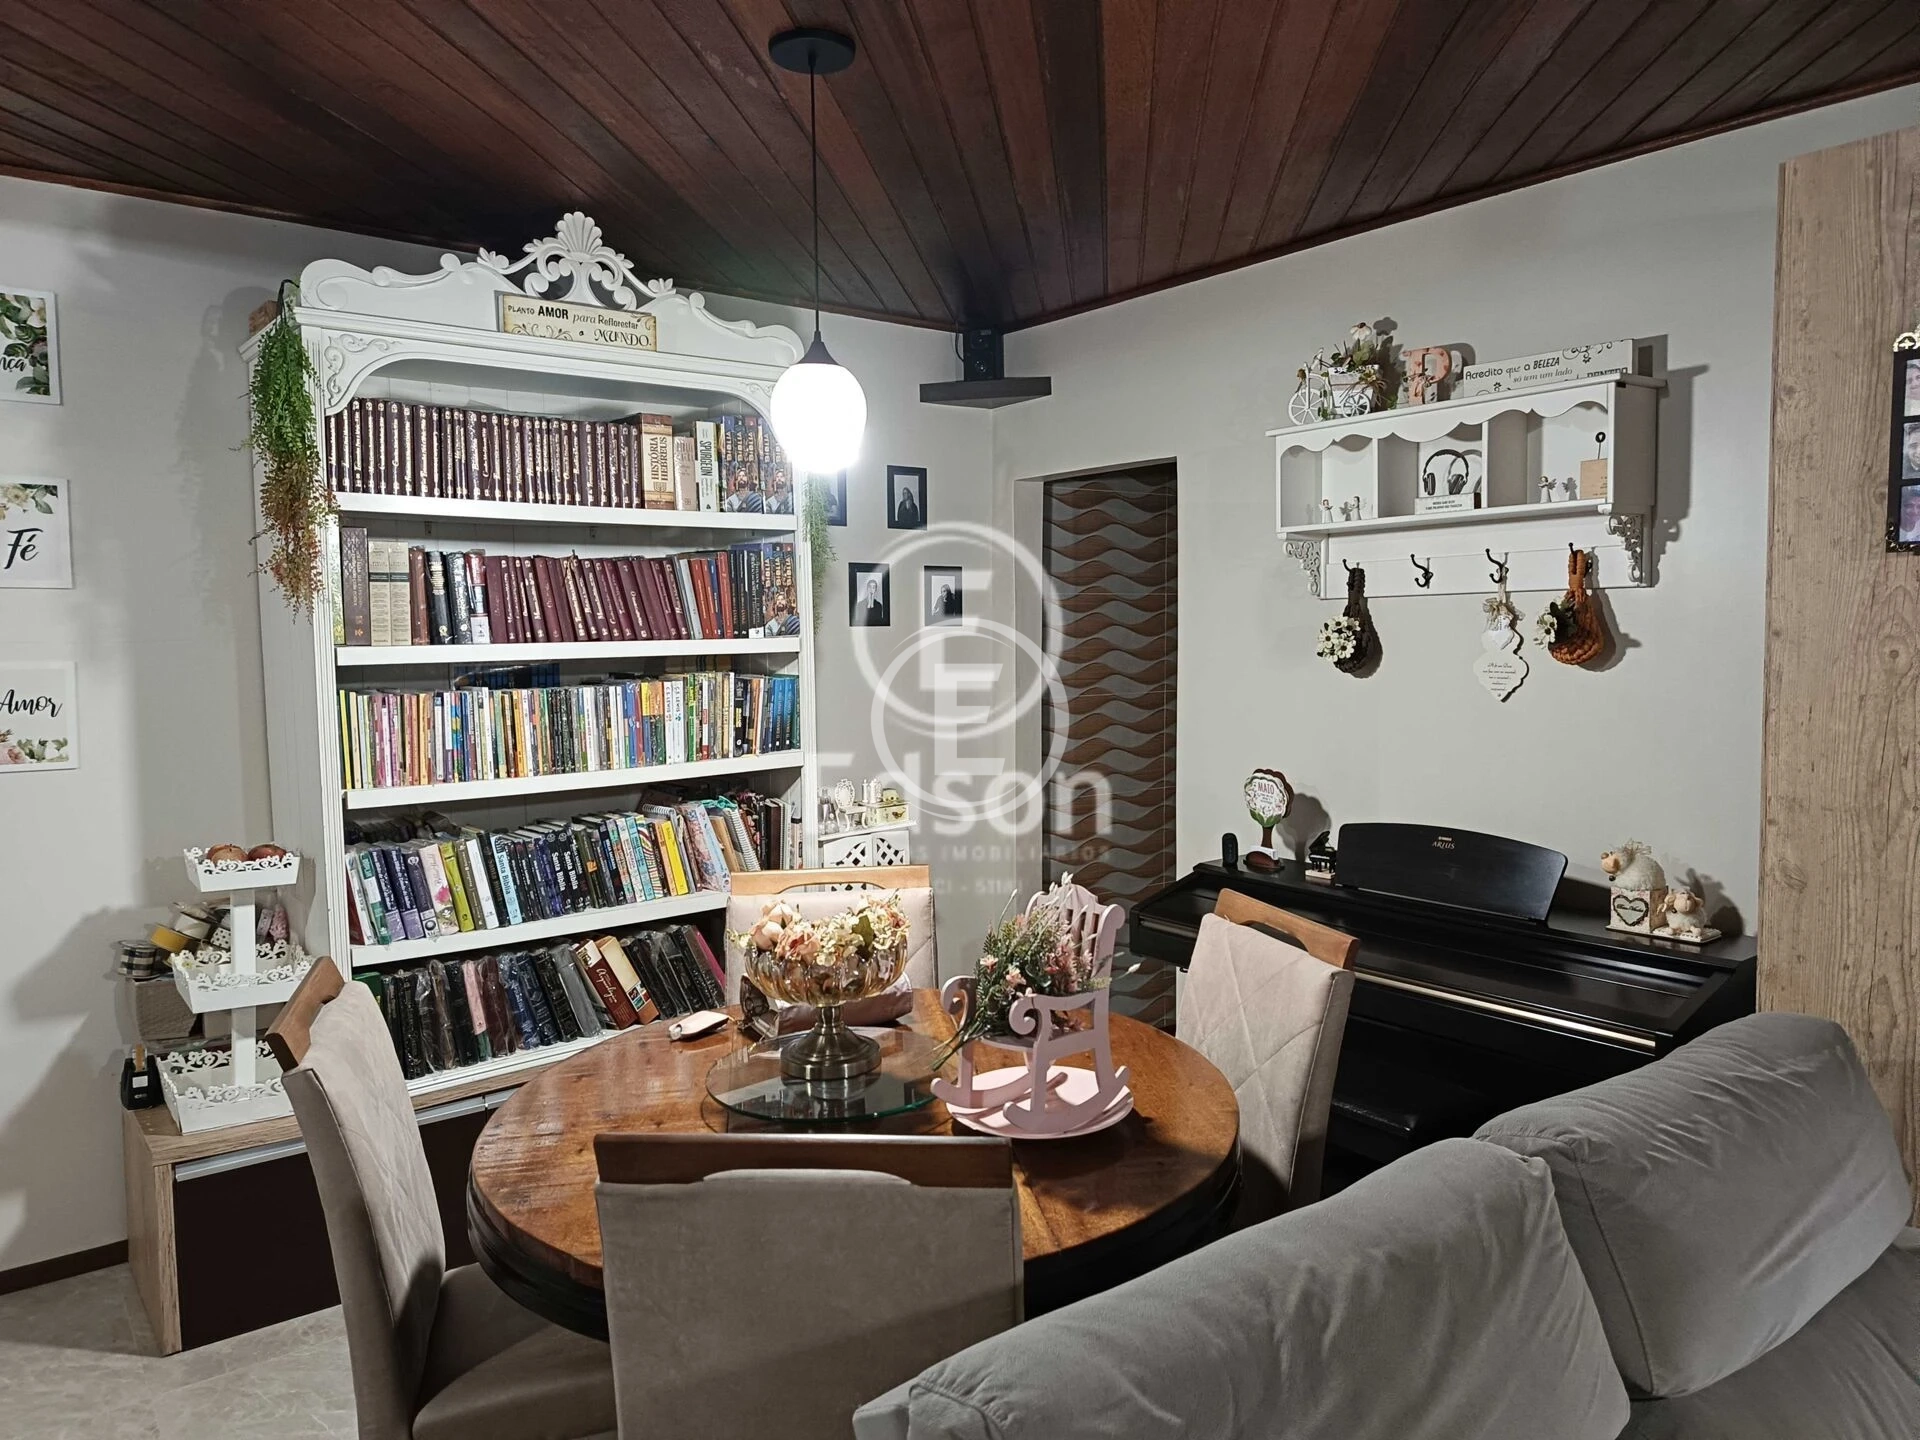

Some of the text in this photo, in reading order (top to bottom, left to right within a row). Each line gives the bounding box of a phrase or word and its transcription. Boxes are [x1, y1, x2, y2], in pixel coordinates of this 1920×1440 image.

[538, 305, 569, 320] AMOR
[572, 313, 596, 325] para
[597, 314, 639, 330] Reflorestar
[1465, 368, 1503, 380] Acredito
[1532, 356, 1560, 370] BELEZA
[1554, 367, 1573, 377] lado
[659, 436, 669, 481] HEBREUS
[699, 440, 713, 477] SPURGEON
[4, 527, 44, 570] Fé
[0, 689, 63, 718] Amor
[496, 854, 507, 873] Santa
[551, 851, 562, 871] Santa
[563, 850, 574, 870] Santa
